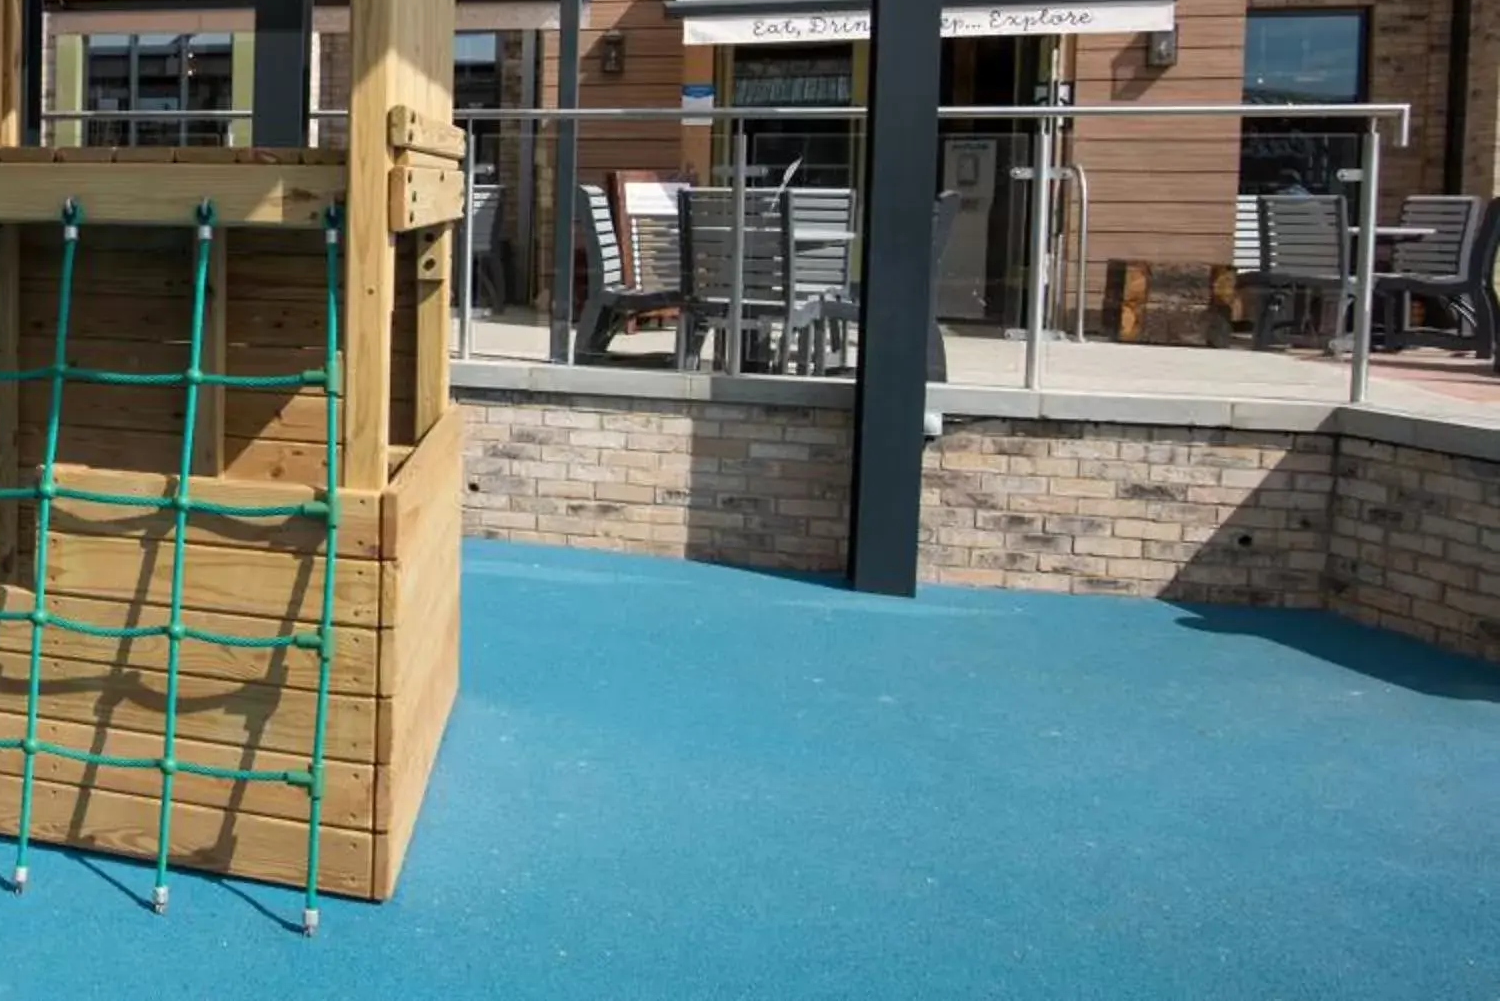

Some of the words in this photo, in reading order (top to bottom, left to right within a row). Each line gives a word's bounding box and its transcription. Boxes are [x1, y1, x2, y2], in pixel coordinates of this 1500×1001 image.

[753, 19, 801, 37] Eat,
[808, 16, 871, 34] Drin
[989, 8, 1094, 32] Explore
